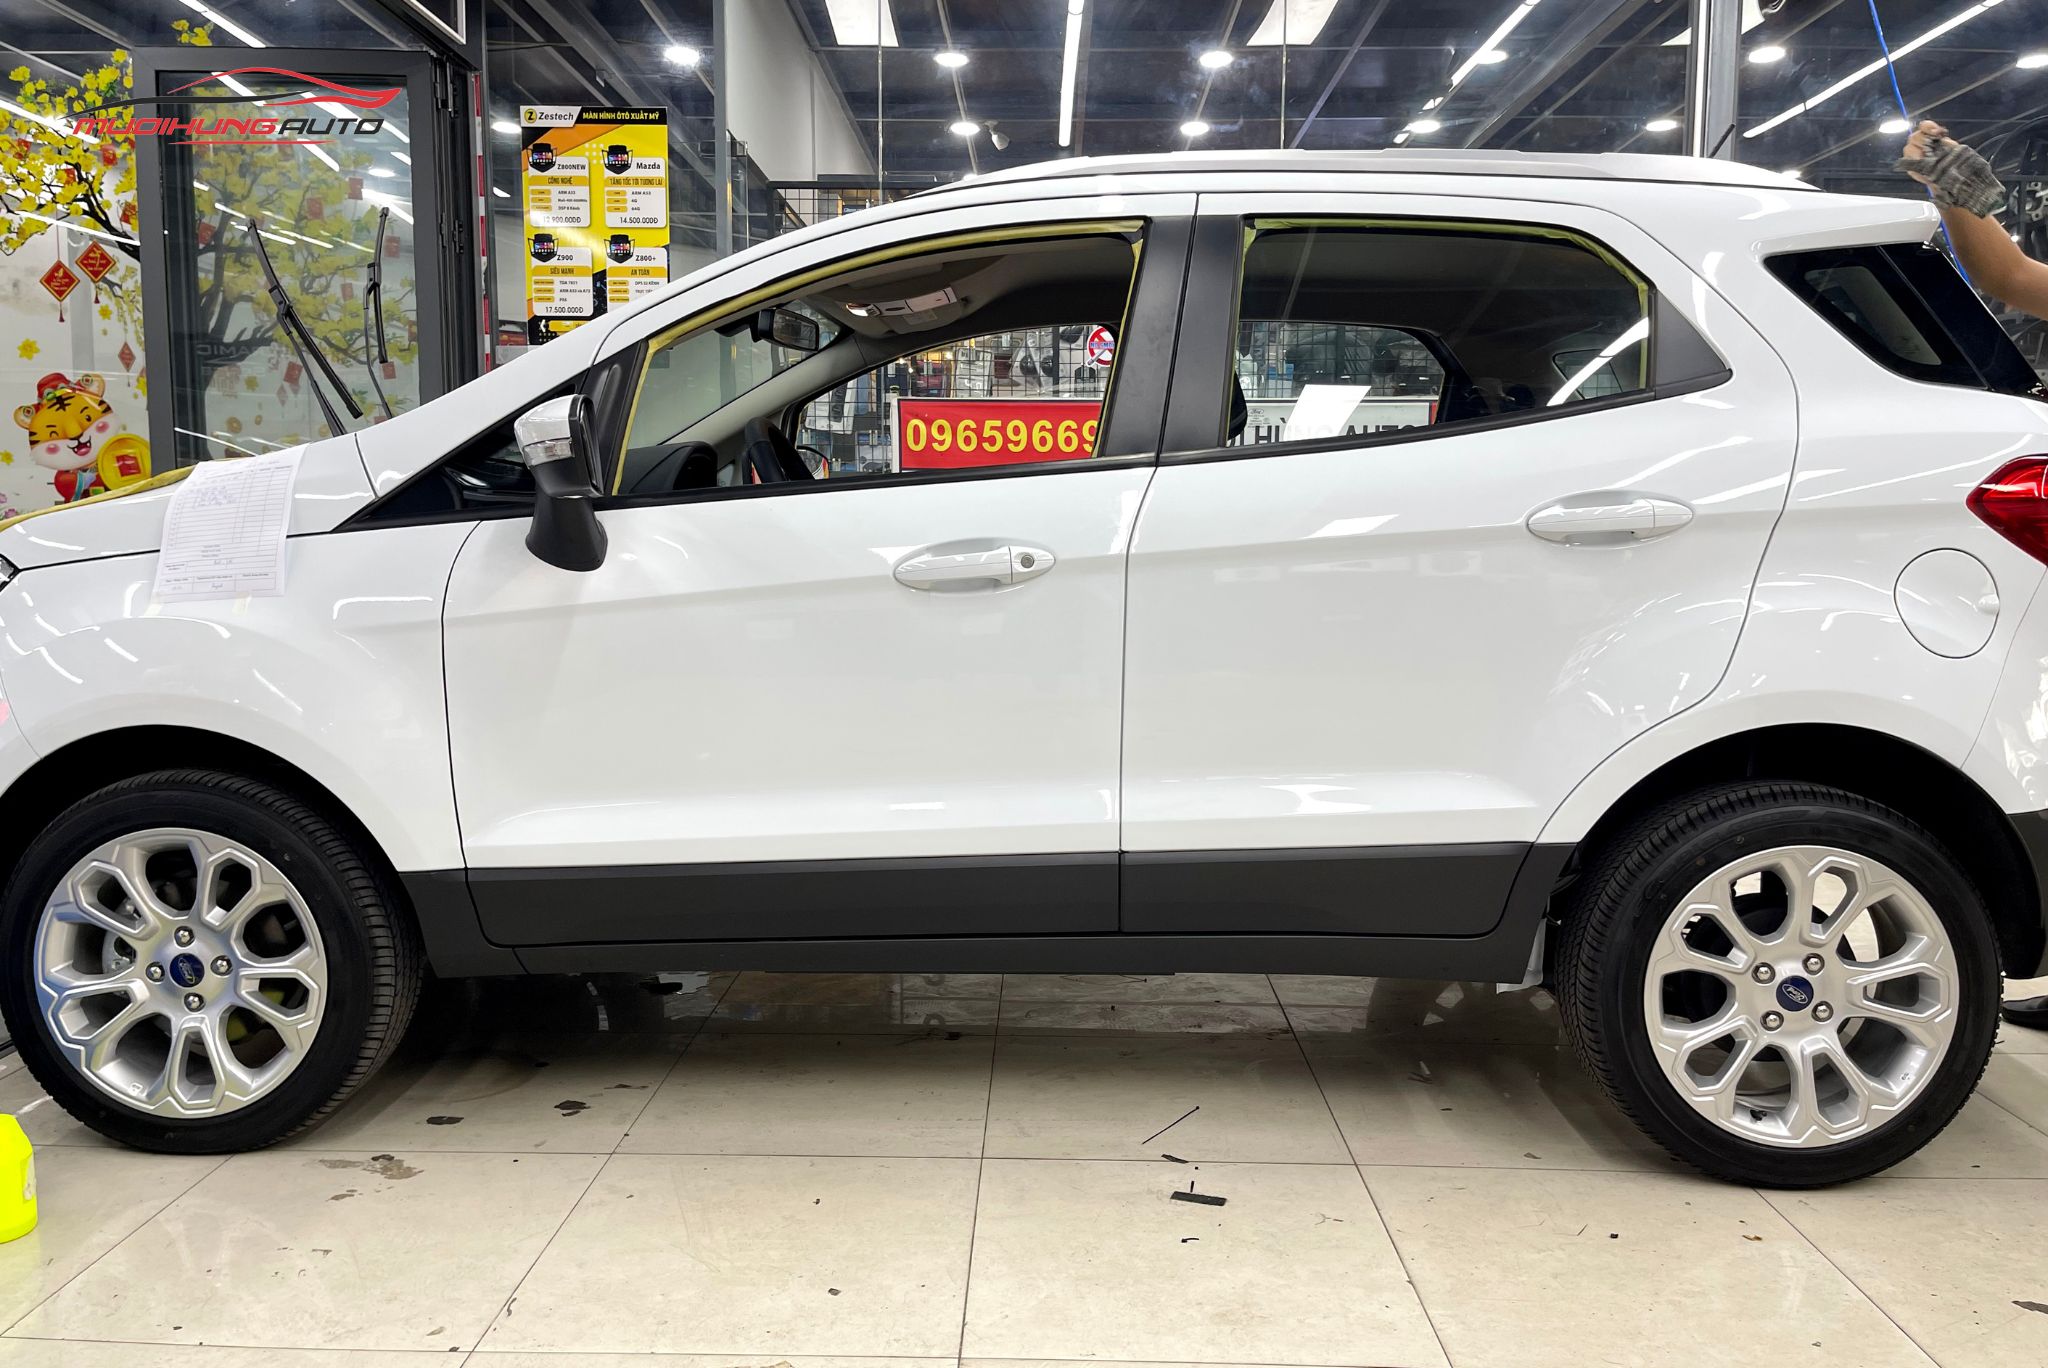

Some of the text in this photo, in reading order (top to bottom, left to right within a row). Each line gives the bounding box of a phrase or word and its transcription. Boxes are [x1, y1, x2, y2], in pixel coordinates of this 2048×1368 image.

[538, 111, 574, 121] Zestech
[582, 110, 599, 120] MÀN
[599, 110, 616, 120] HÌNH
[630, 109, 649, 120] XUẤT
[648, 111, 660, 120] MỸ
[636, 162, 661, 170] Mazda
[655, 178, 663, 186] LAI
[620, 216, 659, 224] 14.500.000Đ
[545, 306, 584, 314] 17.500.000Đ
[906, 418, 1099, 453] 09659669
